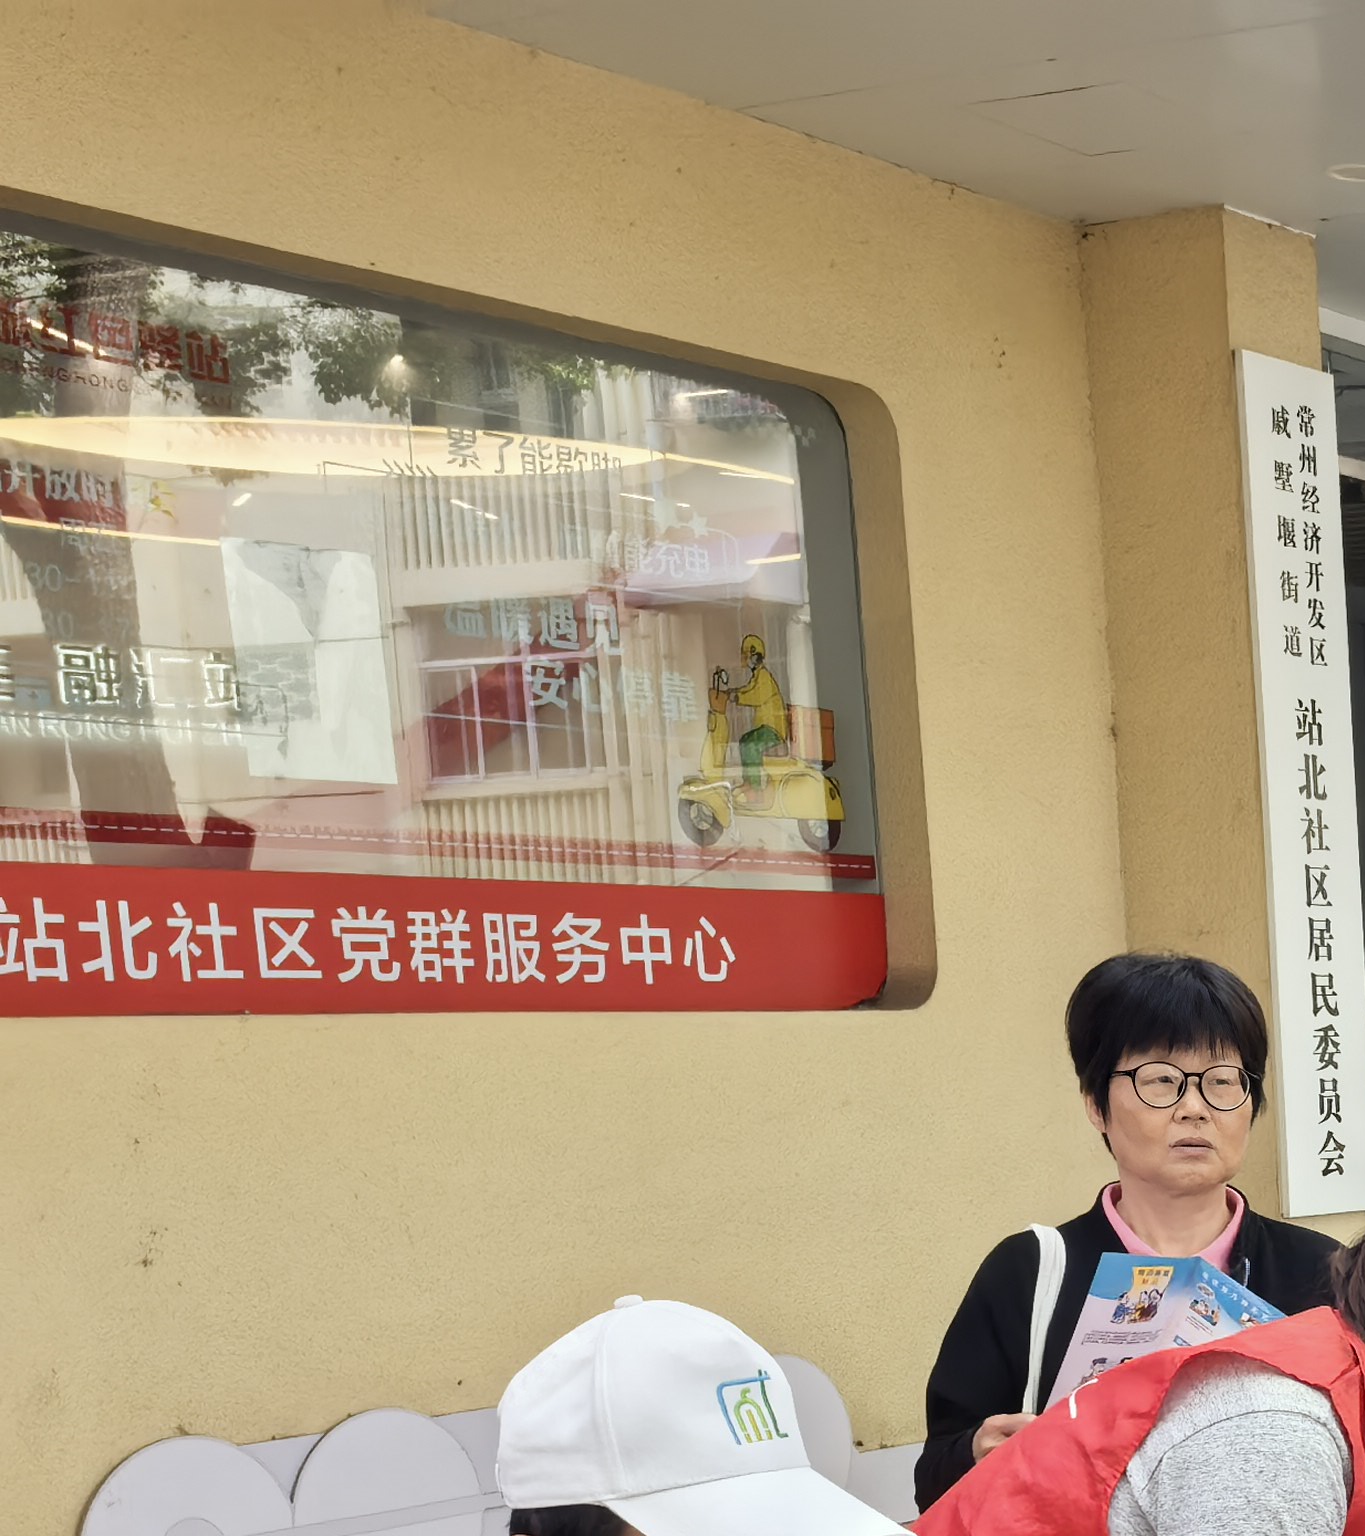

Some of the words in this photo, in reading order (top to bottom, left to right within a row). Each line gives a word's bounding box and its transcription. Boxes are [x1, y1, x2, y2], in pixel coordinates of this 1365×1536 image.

[1270, 405, 1304, 658] 戚墅堰街道
[1296, 404, 1329, 668] 常州经济开发区
[525, 658, 699, 723] 安心停靠
[0, 896, 736, 984] 站北社区党群服务中心
[1295, 697, 1347, 1178] 站北社区居民委员会
